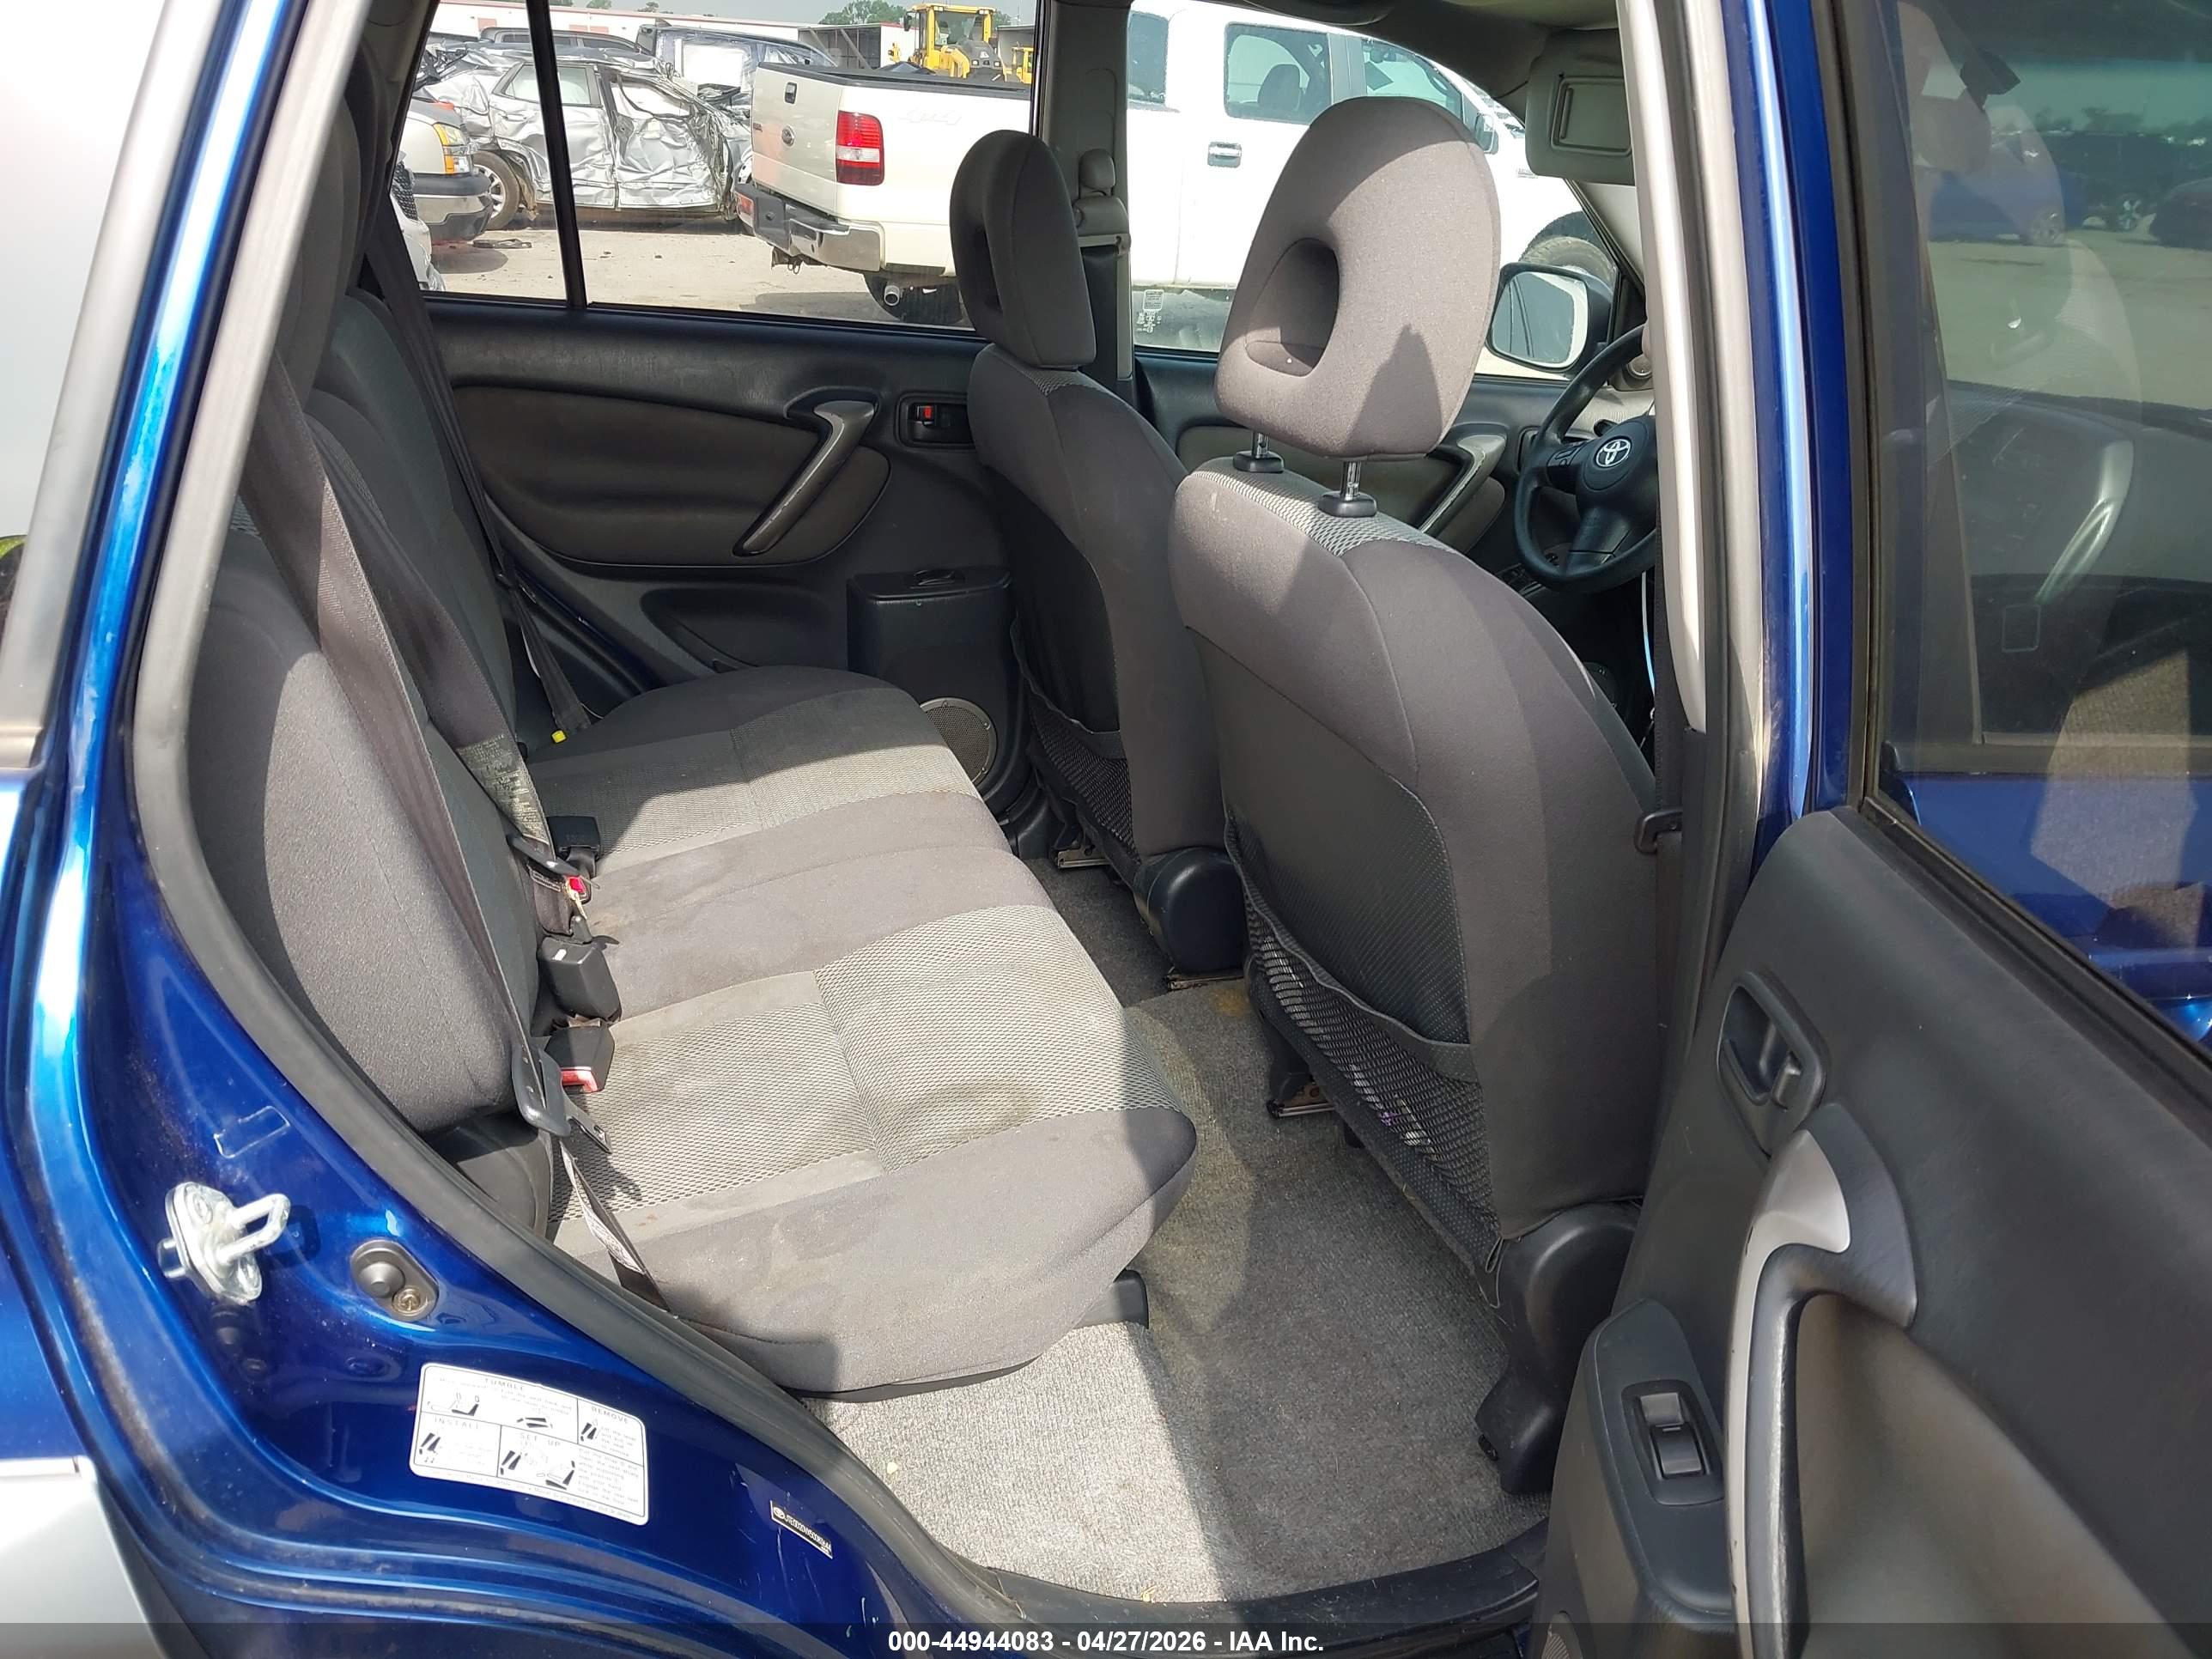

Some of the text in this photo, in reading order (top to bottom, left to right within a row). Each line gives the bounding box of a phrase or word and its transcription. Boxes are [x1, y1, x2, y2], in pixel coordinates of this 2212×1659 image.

[591, 1405, 629, 1425] REMOVE
[434, 1417, 481, 1430] INSTALL
[548, 1438, 562, 1448] UP
